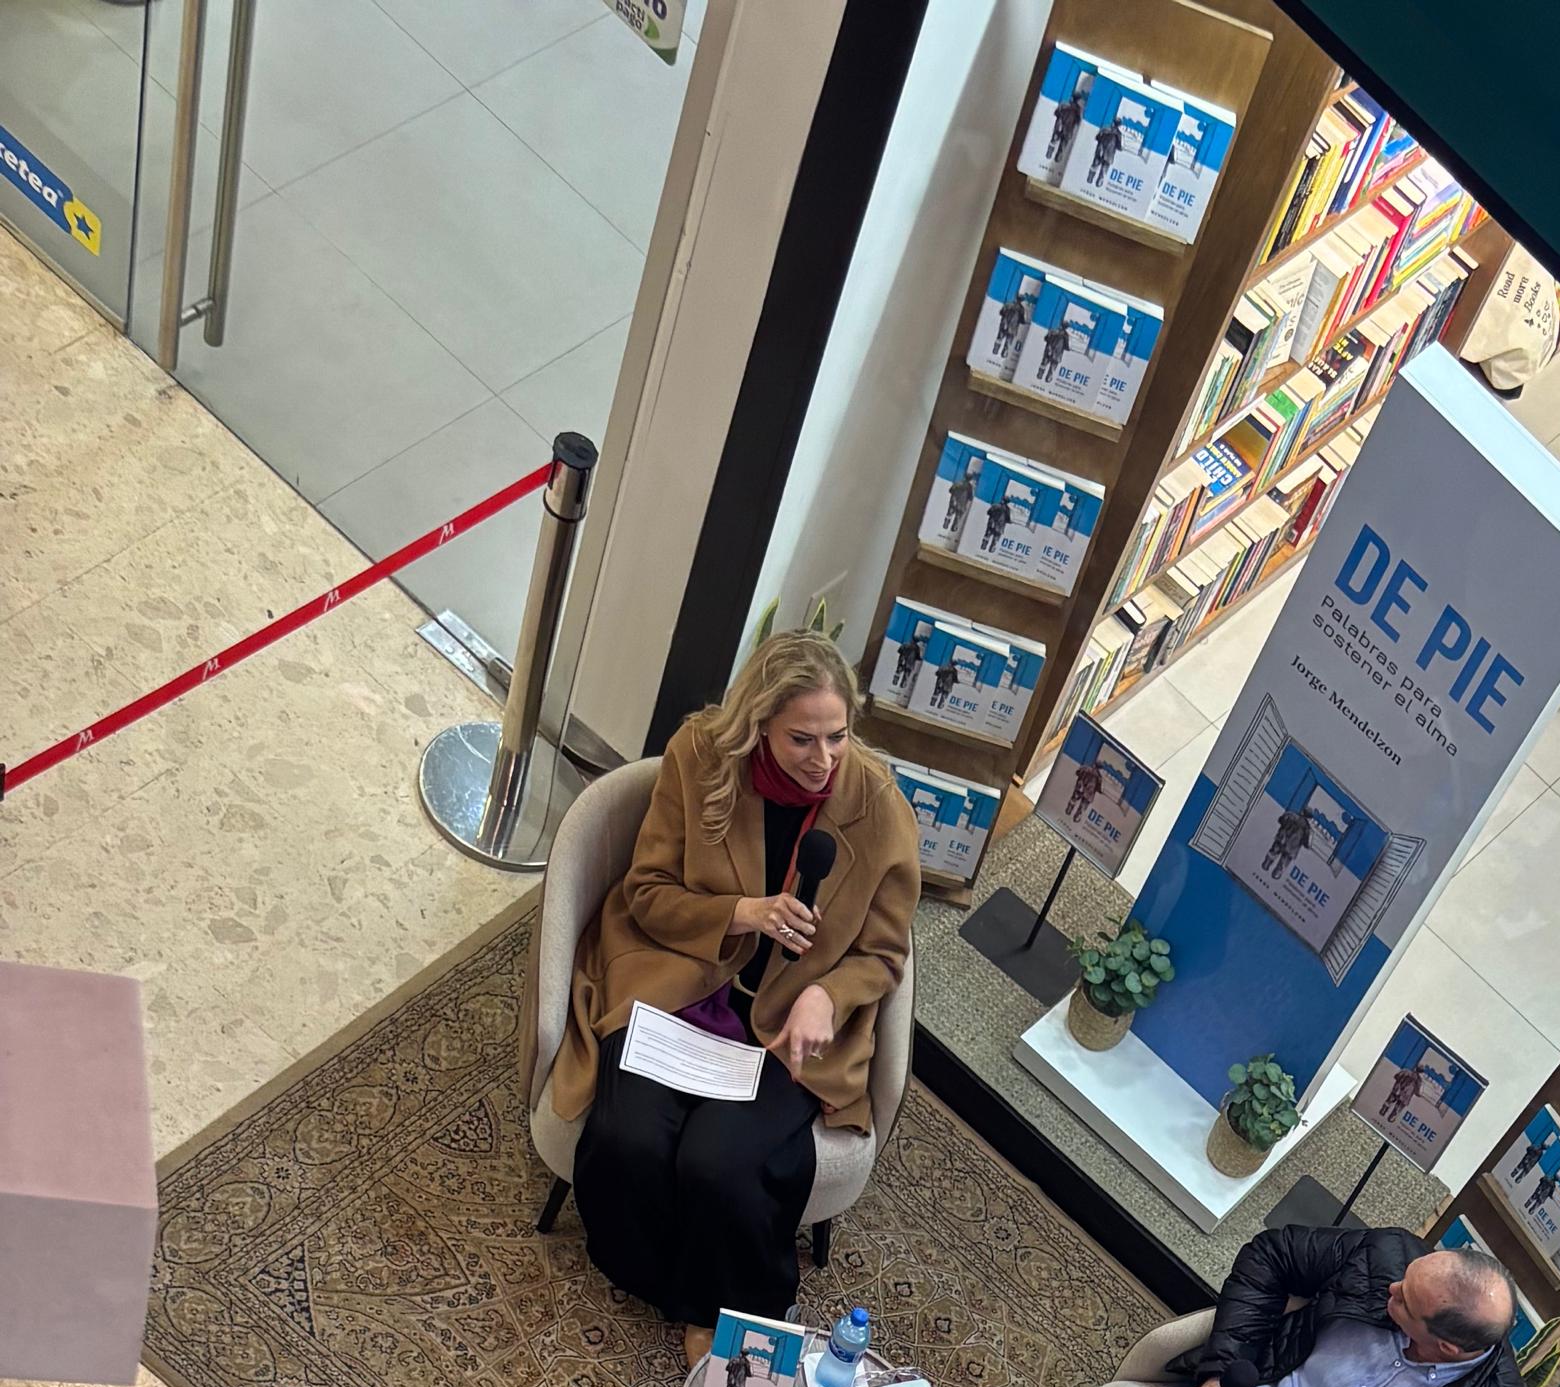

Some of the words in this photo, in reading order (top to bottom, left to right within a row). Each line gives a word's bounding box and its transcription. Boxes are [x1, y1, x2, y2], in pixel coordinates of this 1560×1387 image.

[1110, 168, 1123, 184] DE
[1126, 175, 1144, 192] PIE
[1161, 182, 1175, 197] DE
[1177, 189, 1196, 207] PIE
[1074, 372, 1091, 387] PIE
[1195, 449, 1233, 486] CHILD
[1334, 524, 1429, 643] DE
[1415, 604, 1525, 735] PIE
[1320, 595, 1399, 675] Palabras
[1399, 675, 1442, 718] para
[1312, 614, 1392, 690] sostener
[1394, 693, 1414, 713] el
[1415, 712, 1458, 757] alma
[1290, 655, 1328, 694] Jorge
[1329, 691, 1402, 766] Mendelzon
[1103, 823, 1122, 843] PIE
[1290, 865, 1309, 888] DE
[1307, 882, 1330, 908] PIE
[1402, 1110, 1419, 1127] DE
[1417, 1123, 1437, 1142] PIE
